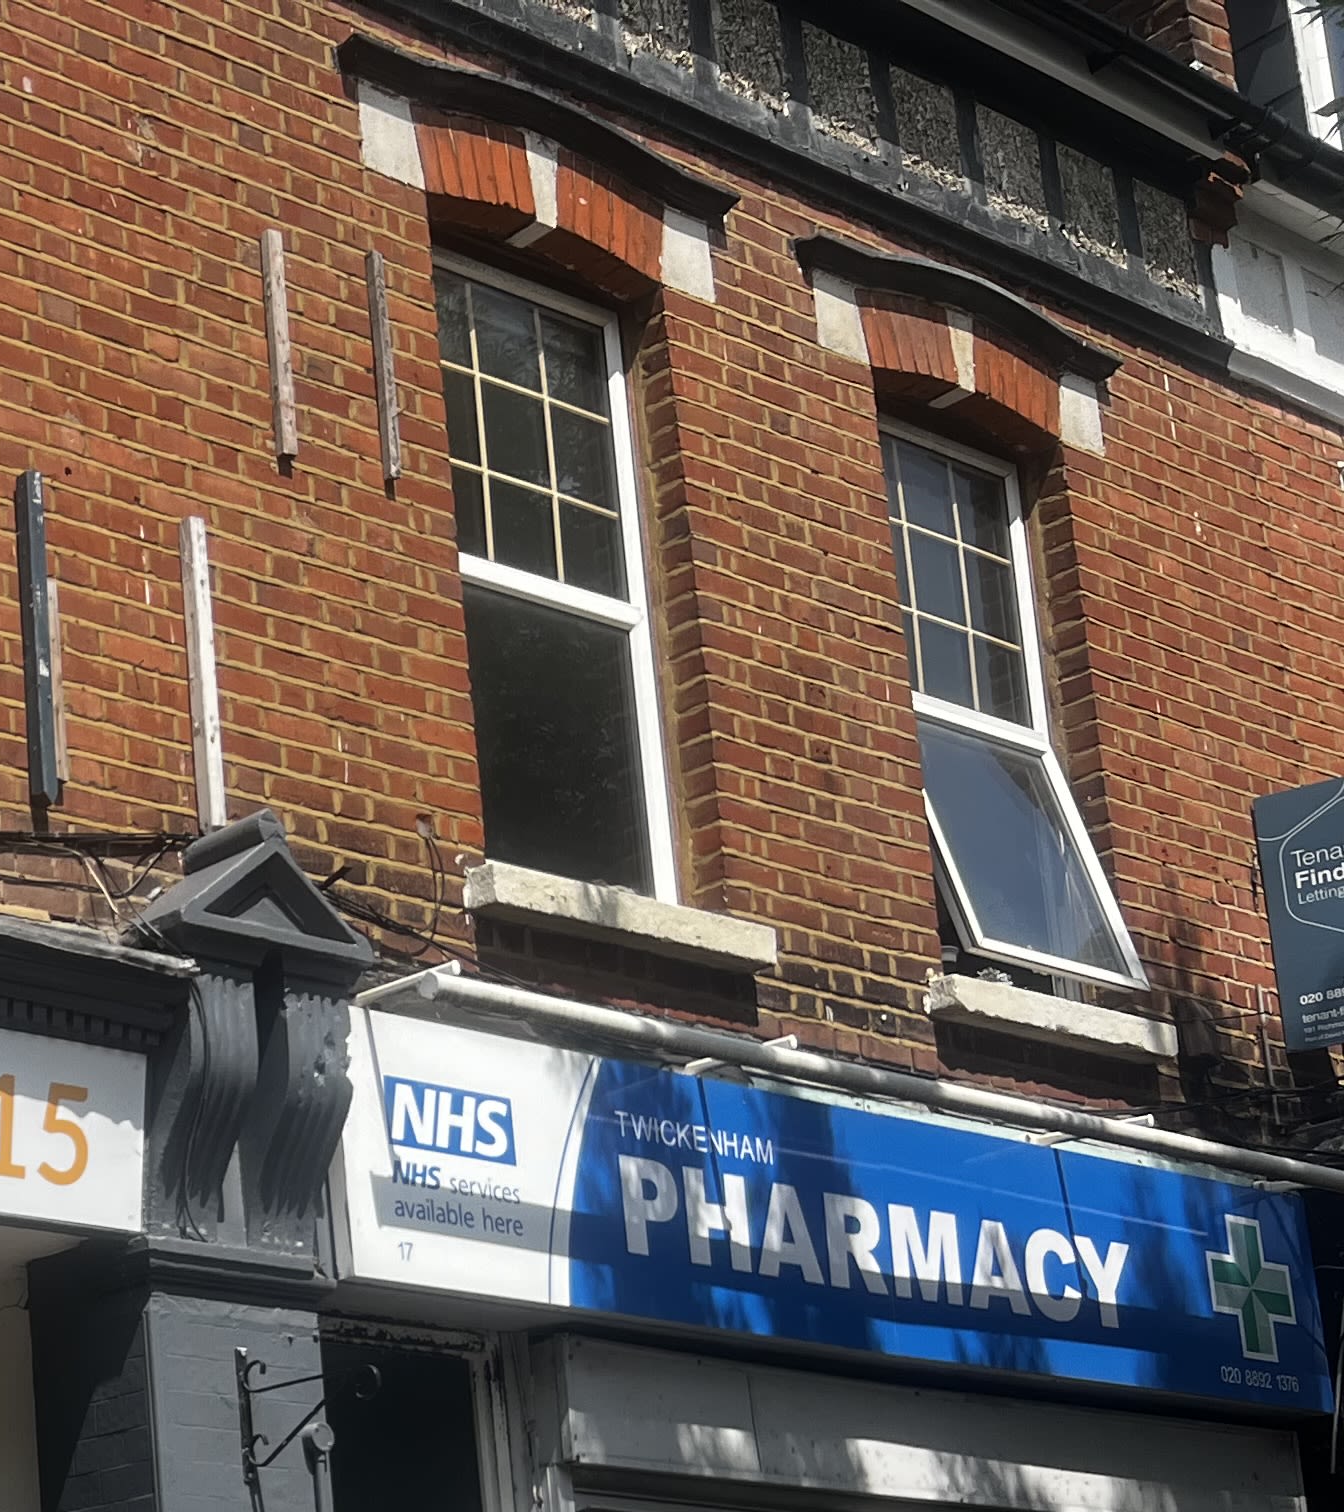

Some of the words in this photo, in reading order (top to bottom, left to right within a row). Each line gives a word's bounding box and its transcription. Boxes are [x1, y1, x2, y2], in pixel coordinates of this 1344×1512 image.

[1299, 991, 1324, 1005] 020
[391, 1082, 508, 1158] NHS
[614, 1110, 775, 1166] TWICKENHAM
[392, 1159, 441, 1191] NHS
[449, 1176, 521, 1205] services
[394, 1198, 475, 1229] available
[482, 1207, 524, 1237] here
[398, 1242, 413, 1261] 17
[617, 1154, 1130, 1329] PHARMACY
[1220, 1365, 1242, 1385] 020
[1245, 1369, 1272, 1389] 8892
